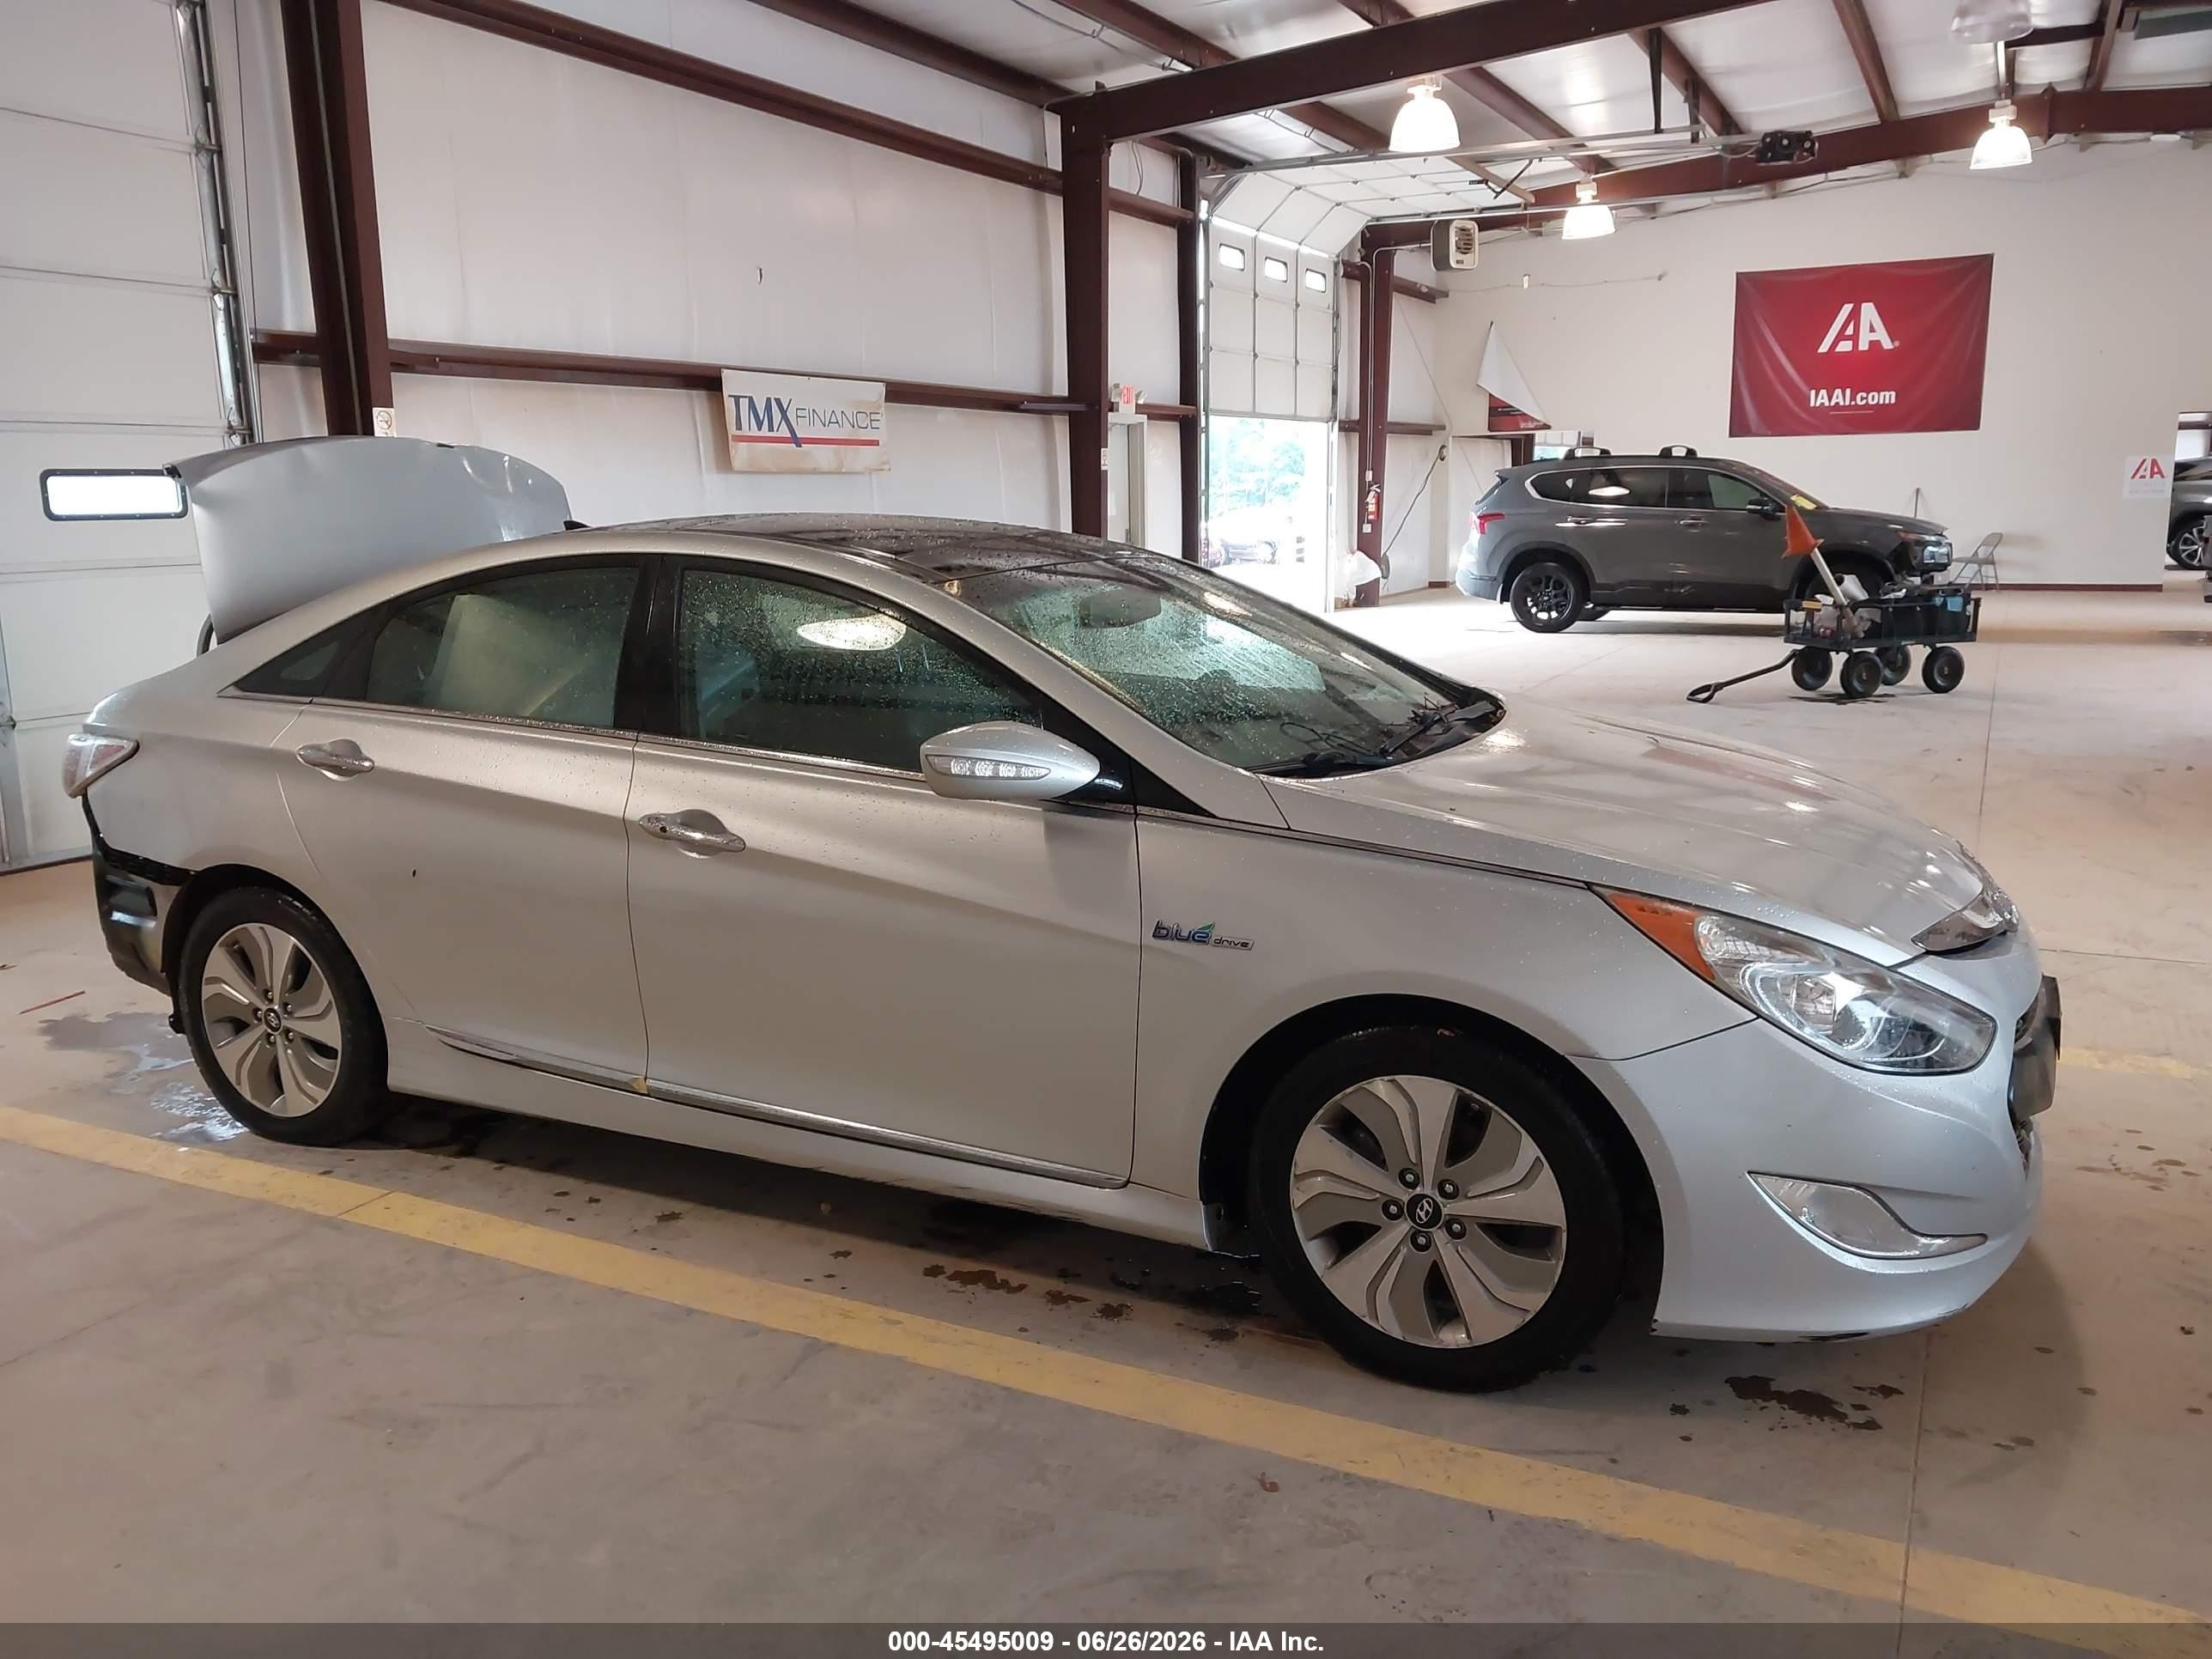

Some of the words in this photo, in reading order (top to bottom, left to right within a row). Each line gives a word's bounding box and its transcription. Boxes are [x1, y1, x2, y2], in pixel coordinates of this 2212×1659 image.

[1809, 387, 1897, 408] IAAI.com
[727, 394, 803, 448] TMX
[795, 407, 880, 430] FINANCE
[1152, 919, 1213, 945] blue
[1213, 936, 1251, 949] drive
